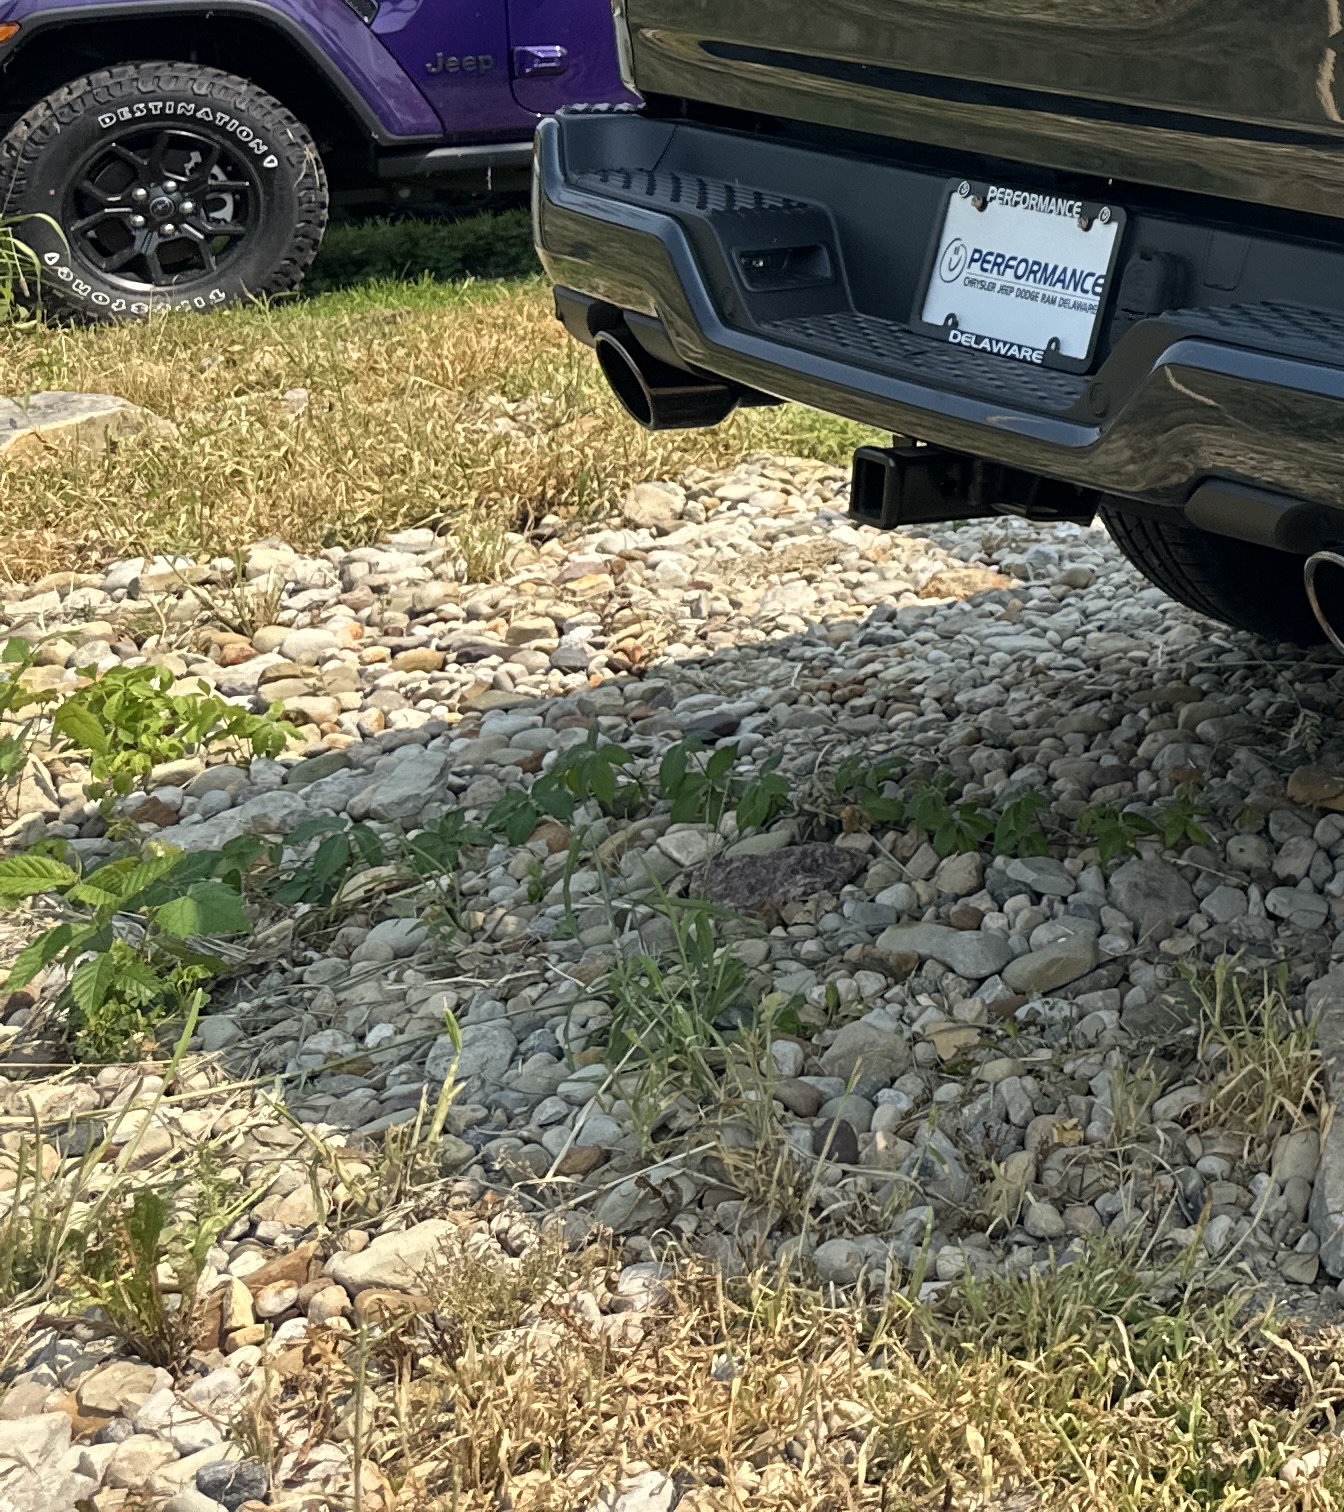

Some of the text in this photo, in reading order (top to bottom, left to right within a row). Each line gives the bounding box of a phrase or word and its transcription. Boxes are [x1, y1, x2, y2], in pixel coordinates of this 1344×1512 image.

[425, 51, 494, 74] Jeep
[97, 101, 269, 155] DESTINATION
[986, 185, 1082, 219] PERFORMANCE
[967, 248, 1106, 296] PERFORMANCE
[963, 277, 997, 292] CHRYSLER
[1015, 288, 1040, 302] DODGE
[1040, 293, 1058, 306] RAM
[949, 329, 1044, 364] DELAWARE
